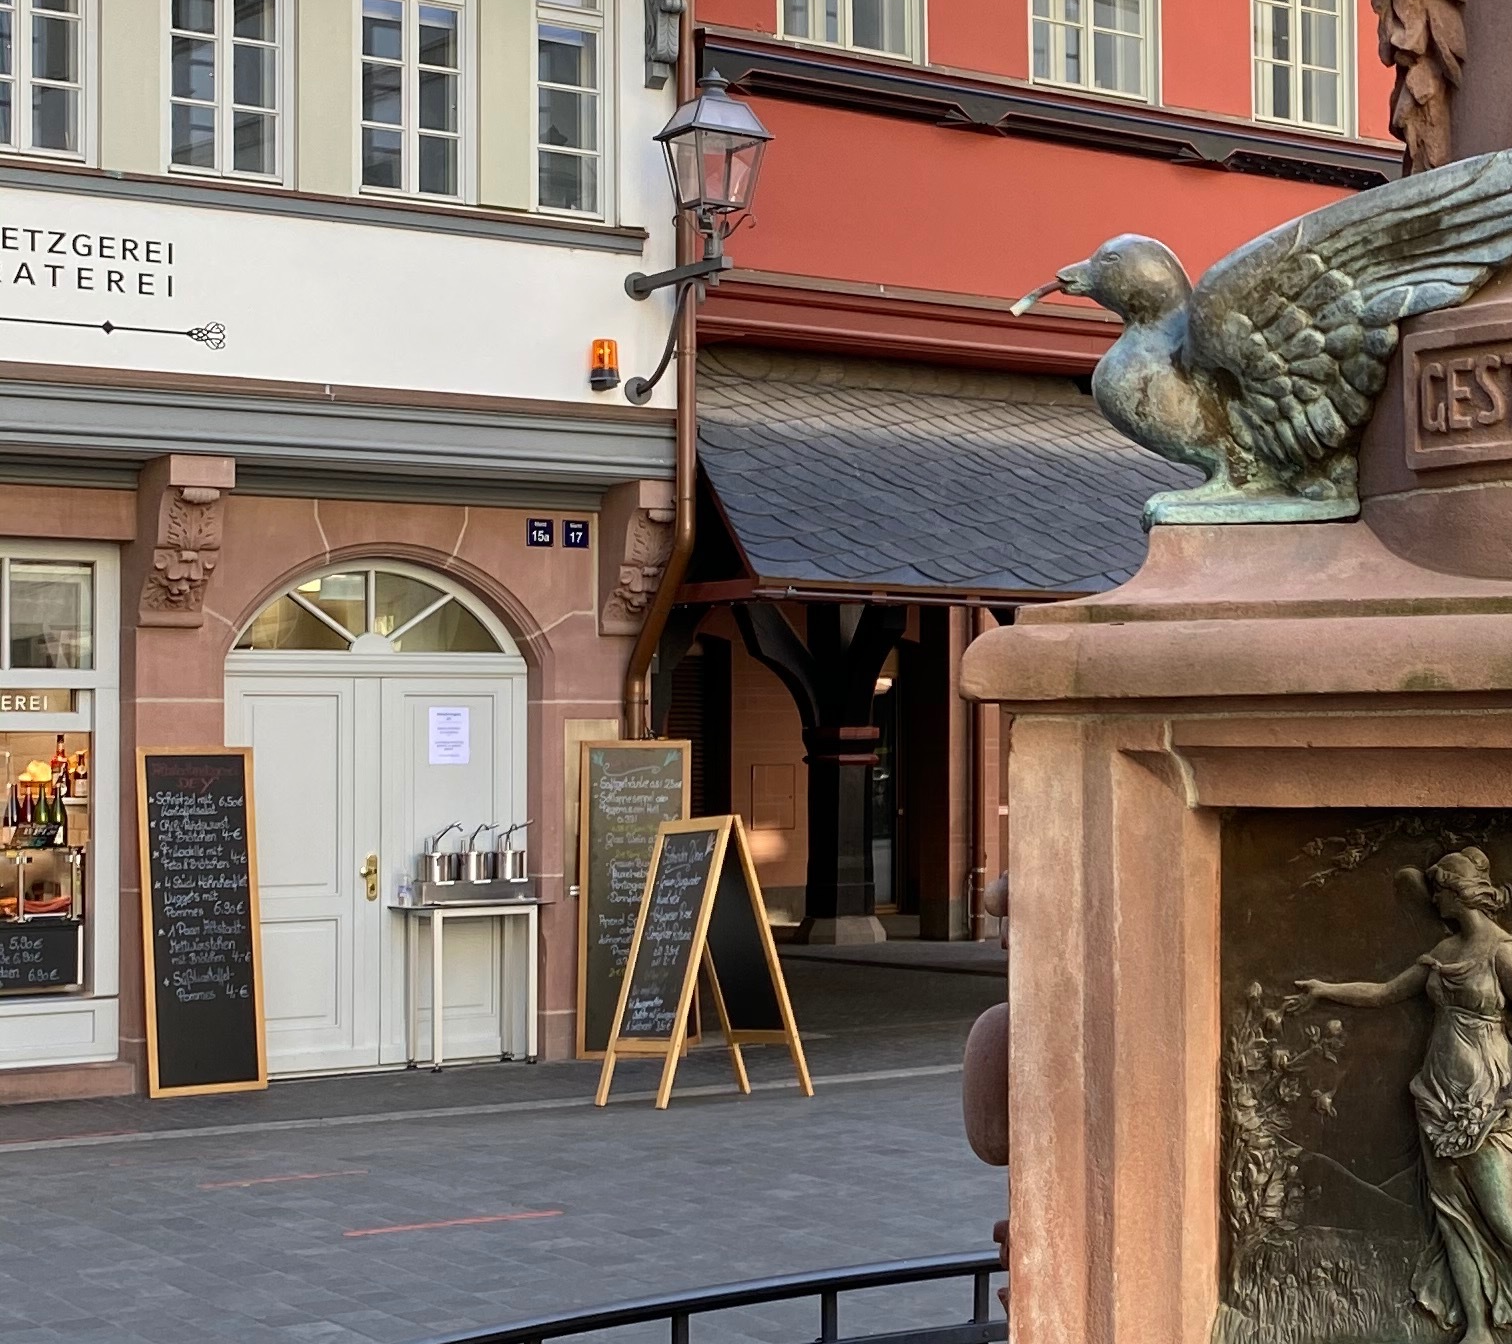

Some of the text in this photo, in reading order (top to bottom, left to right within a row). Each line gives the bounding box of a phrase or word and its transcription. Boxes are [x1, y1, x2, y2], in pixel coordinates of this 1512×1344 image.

[0, 262, 173, 298] ATEREI
[532, 530, 550, 542] 15a
[569, 531, 583, 544] 17
